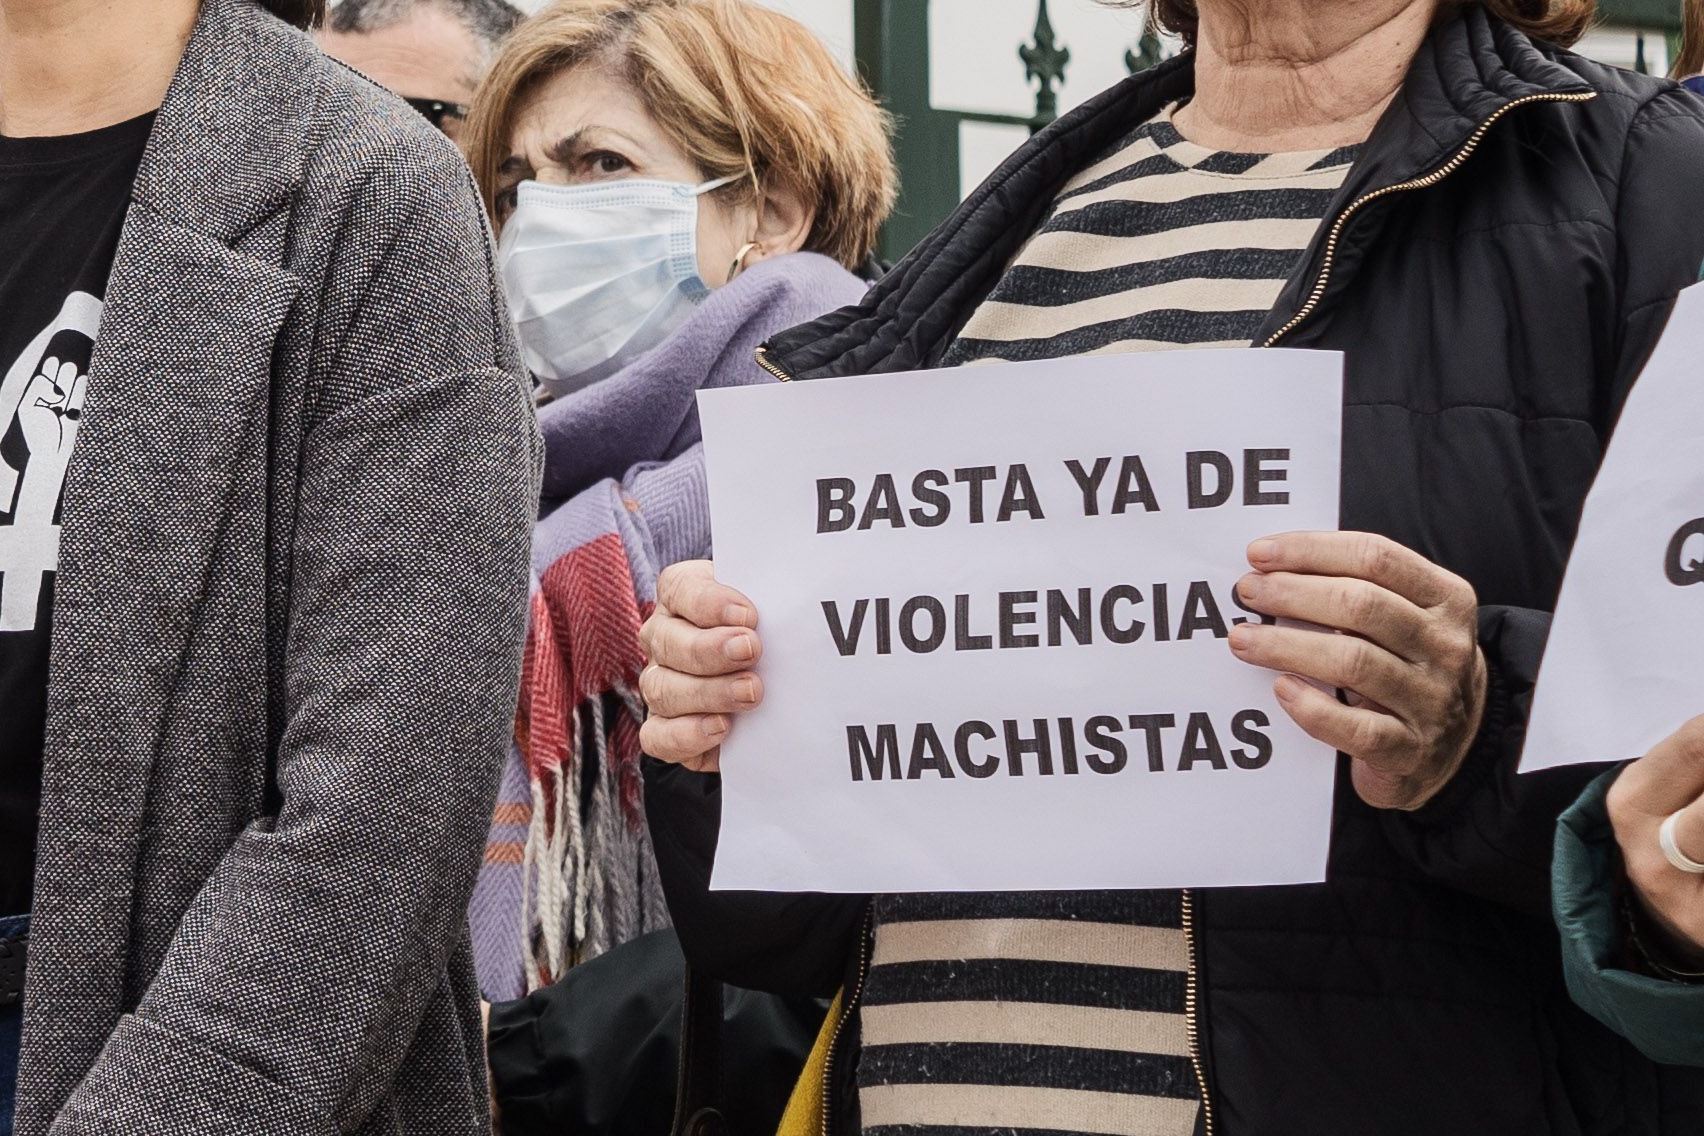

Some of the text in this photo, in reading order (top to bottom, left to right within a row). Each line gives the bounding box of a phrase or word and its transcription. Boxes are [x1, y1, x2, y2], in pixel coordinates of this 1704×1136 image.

[815, 448, 1291, 534] BASTA YA DE
[846, 708, 1274, 782] MACHISTAS
